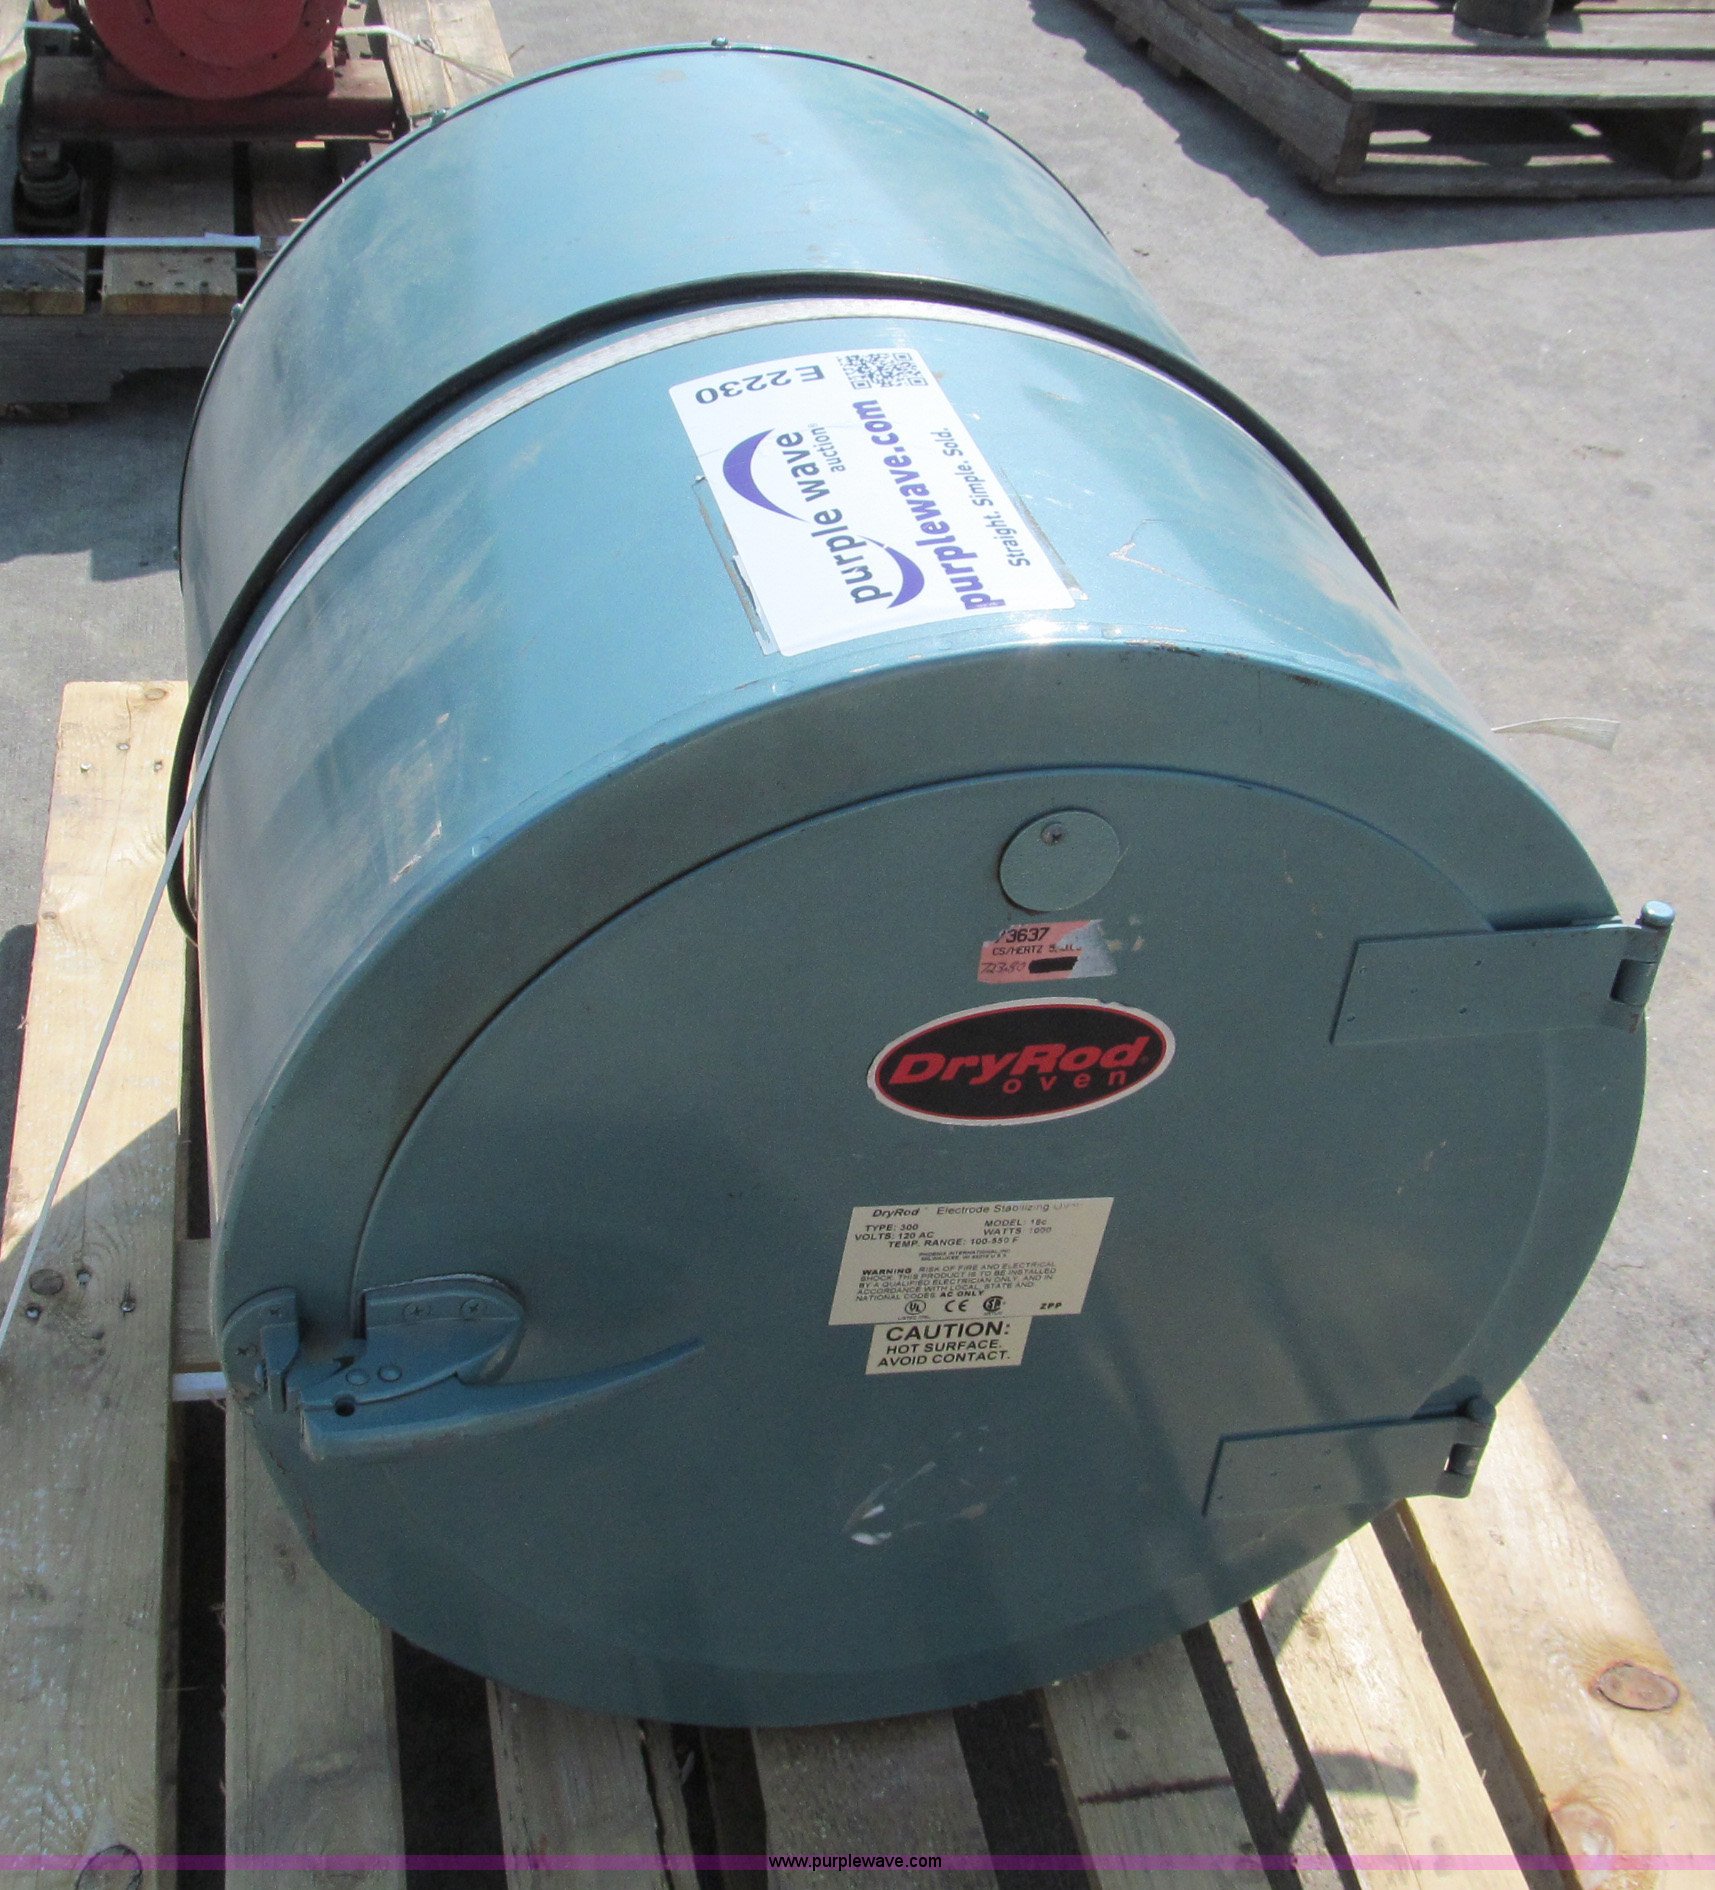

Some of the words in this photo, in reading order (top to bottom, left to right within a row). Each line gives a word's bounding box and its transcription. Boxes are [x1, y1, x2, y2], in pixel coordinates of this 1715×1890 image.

[795, 364, 825, 383] E
[695, 369, 792, 405] 2230
[930, 427, 963, 456] Sold.
[776, 432, 830, 502] wave
[955, 461, 994, 506] Simple.
[852, 400, 1006, 610] purplewave.com
[983, 511, 1031, 567] Straight.
[811, 508, 893, 604] purple
[889, 1036, 1150, 1086] DryRod
[1003, 1069, 1127, 1095] oven
[872, 1208, 921, 1218] DryRod
[936, 1205, 990, 1216] Electrode
[855, 1233, 894, 1241] VOLTS:
[919, 1231, 935, 1239] AC
[865, 1224, 896, 1232] TYPE:
[900, 1223, 919, 1231] 300
[889, 1240, 920, 1248] TEMP.
[924, 1238, 966, 1247] RANGE:
[970, 1237, 1010, 1245] 100-550
[919, 1265, 940, 1273] RISK
[980, 1263, 1000, 1271] AND
[921, 1271, 965, 1279] PRODUCT
[994, 1269, 1006, 1277] BE
[1008, 1267, 1057, 1275] INSTALLED
[857, 1286, 920, 1295] ACCORDANCE
[924, 1284, 948, 1292] WITH
[983, 1281, 1013, 1289] STATE
[882, 1279, 930, 1287] QUALIFIED
[932, 1276, 991, 1285] ELECTRICIAN
[856, 1294, 900, 1302] NATIONAL
[956, 1289, 985, 1297] ONLY
[1040, 1302, 1062, 1310] ZPP
[886, 1321, 1010, 1340] CAUTION:
[886, 1343, 920, 1355] HOT
[924, 1339, 1001, 1353] SURFACE.
[877, 1355, 927, 1367] AVOID
[931, 1350, 1010, 1364] CONTACT.
